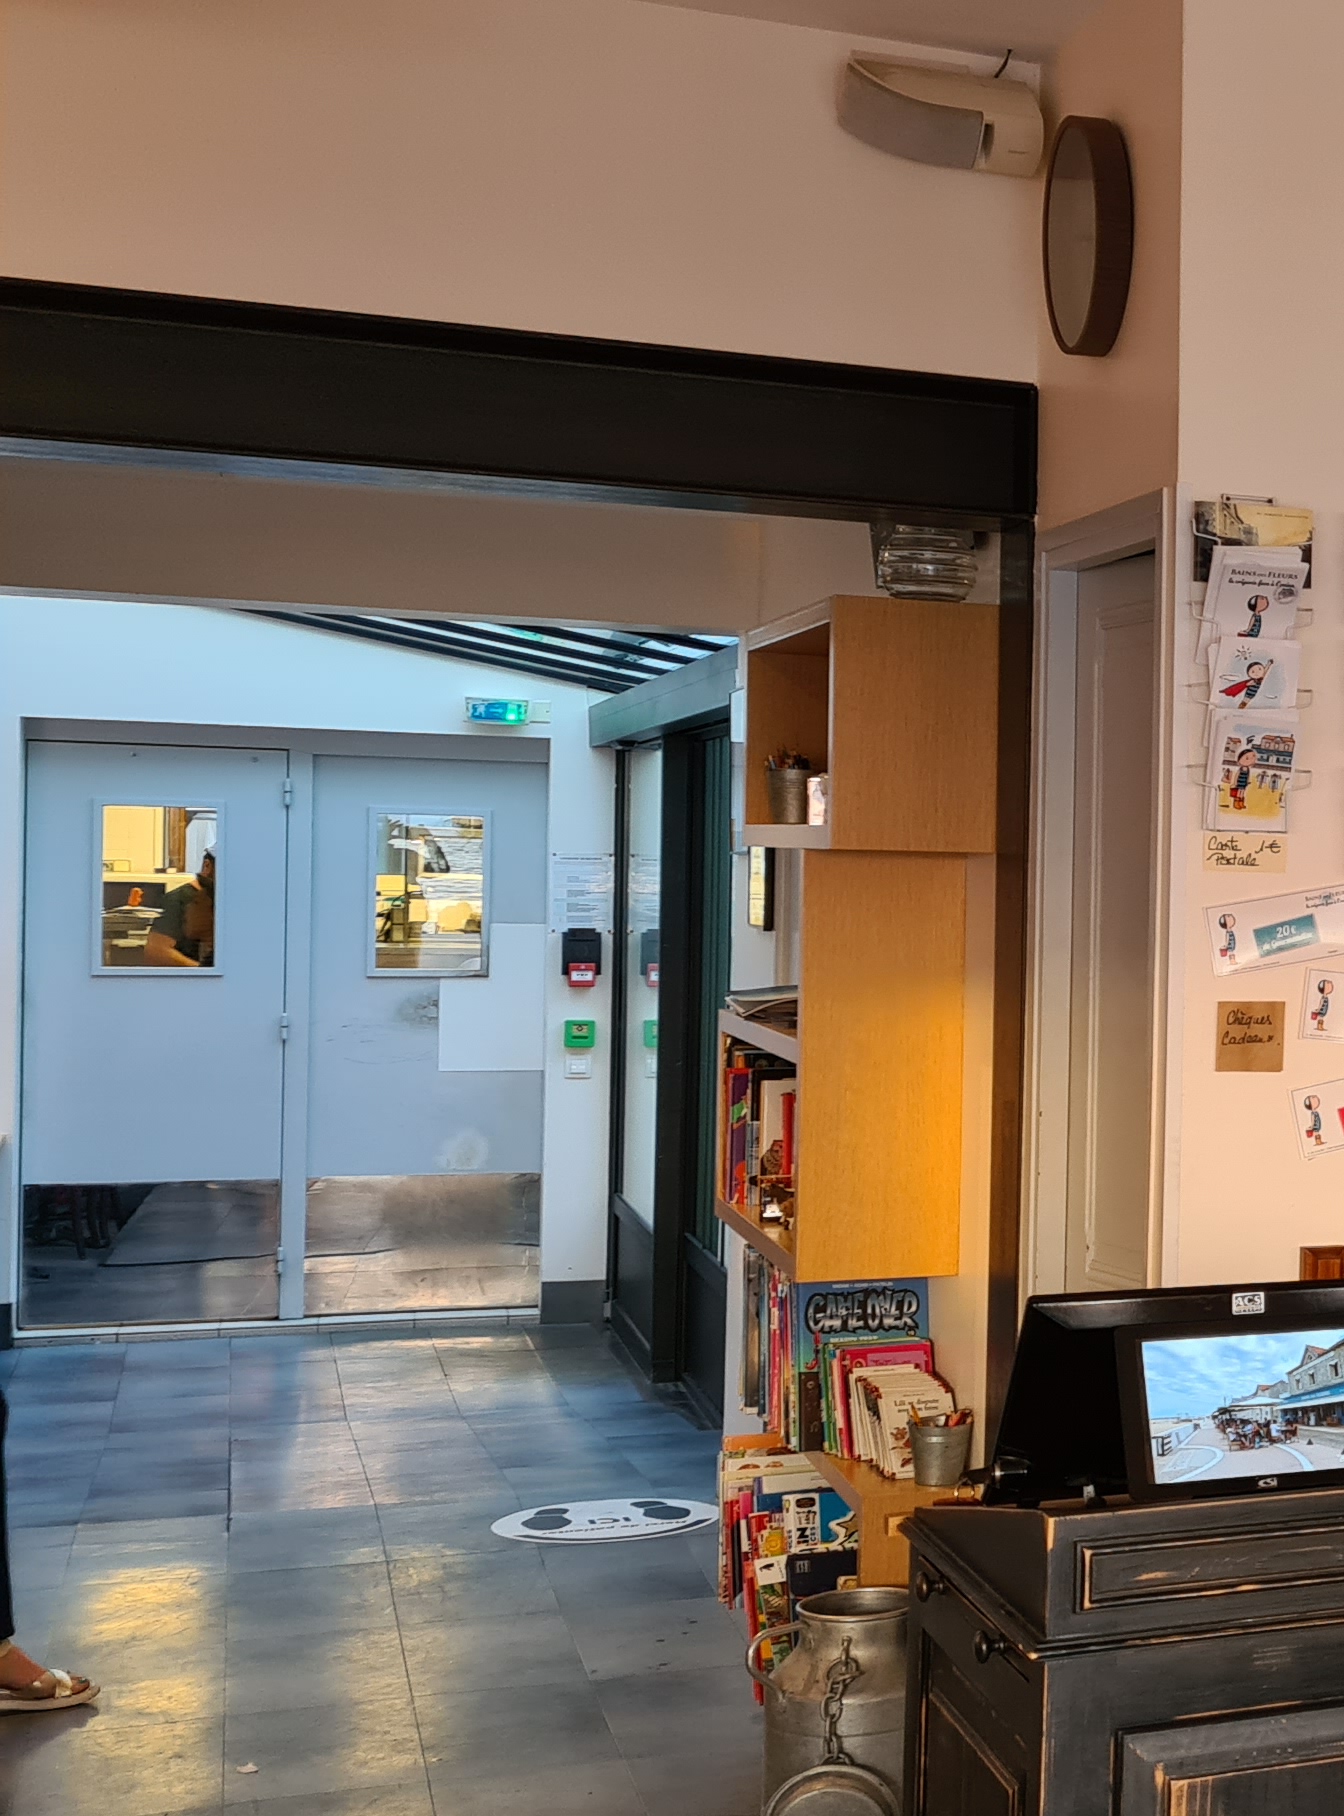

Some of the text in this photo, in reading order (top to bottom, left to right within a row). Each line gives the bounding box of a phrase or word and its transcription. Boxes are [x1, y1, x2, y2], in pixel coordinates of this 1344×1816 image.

[1226, 1008, 1272, 1029] Chèques
[806, 1288, 919, 1334] GAME OVER
